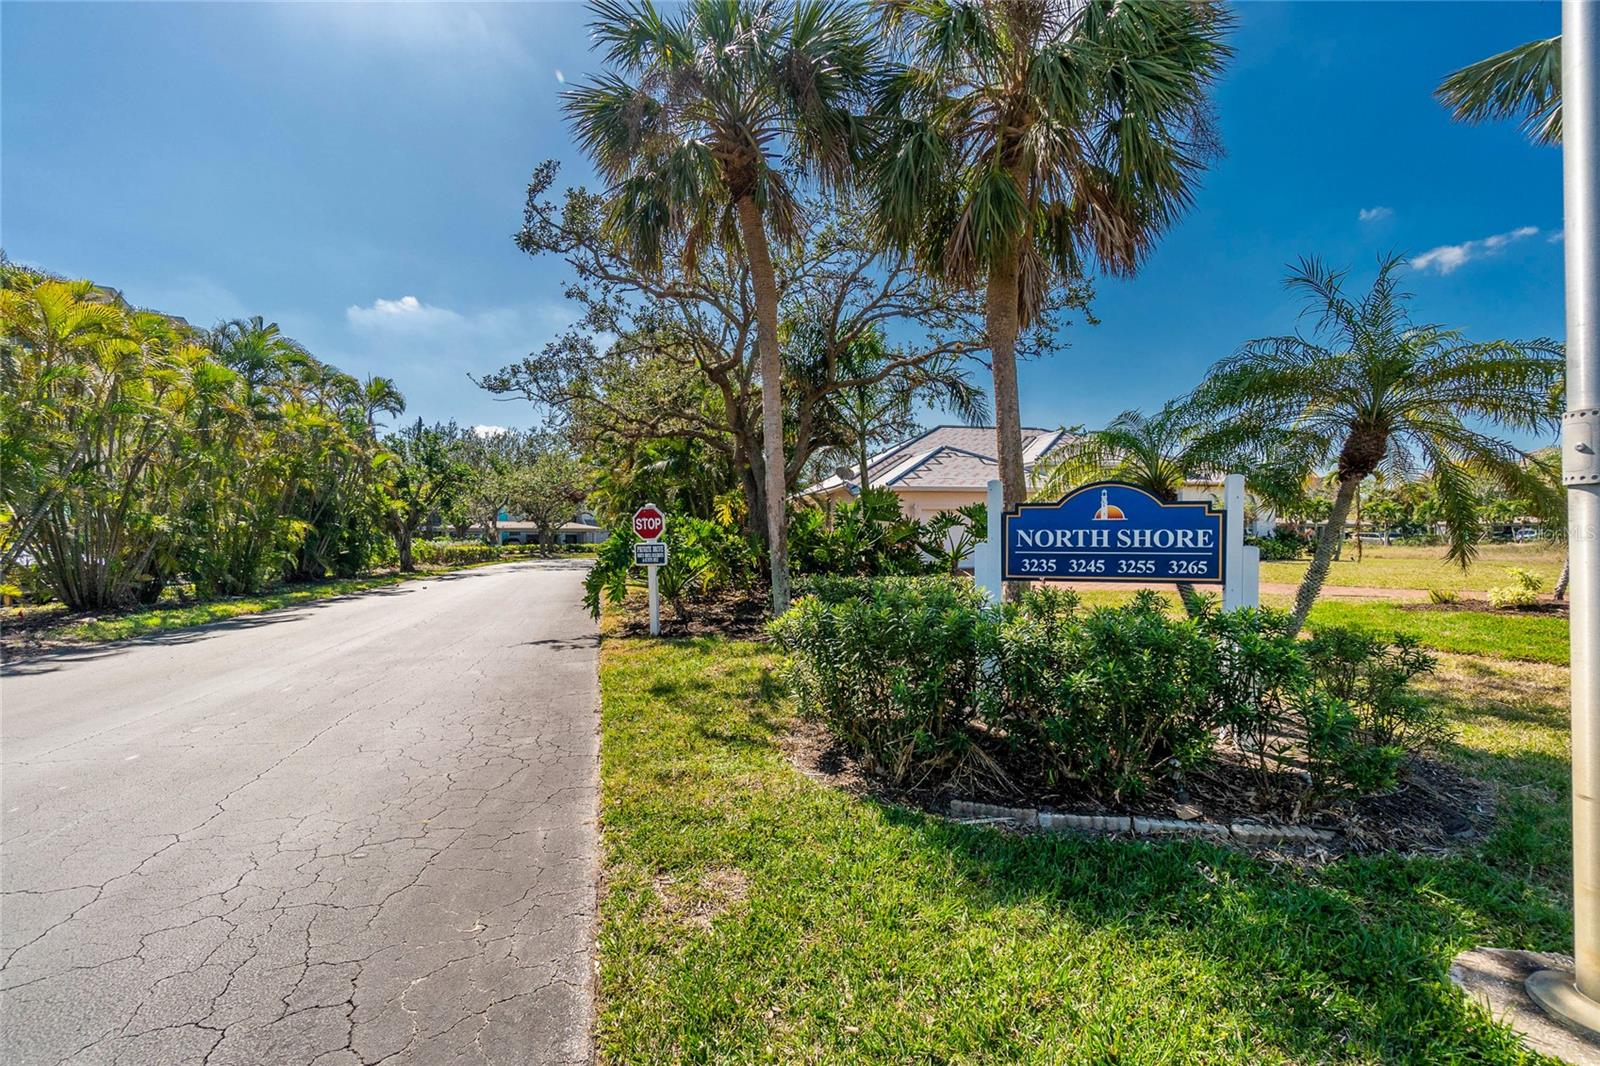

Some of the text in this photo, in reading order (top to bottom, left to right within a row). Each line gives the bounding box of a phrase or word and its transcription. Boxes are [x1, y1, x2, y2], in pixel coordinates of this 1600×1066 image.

[635, 517, 662, 530] STOP
[1015, 528, 1214, 549] NORTH SHORE
[1021, 558, 1208, 575] 3235 3245 3255 3265
